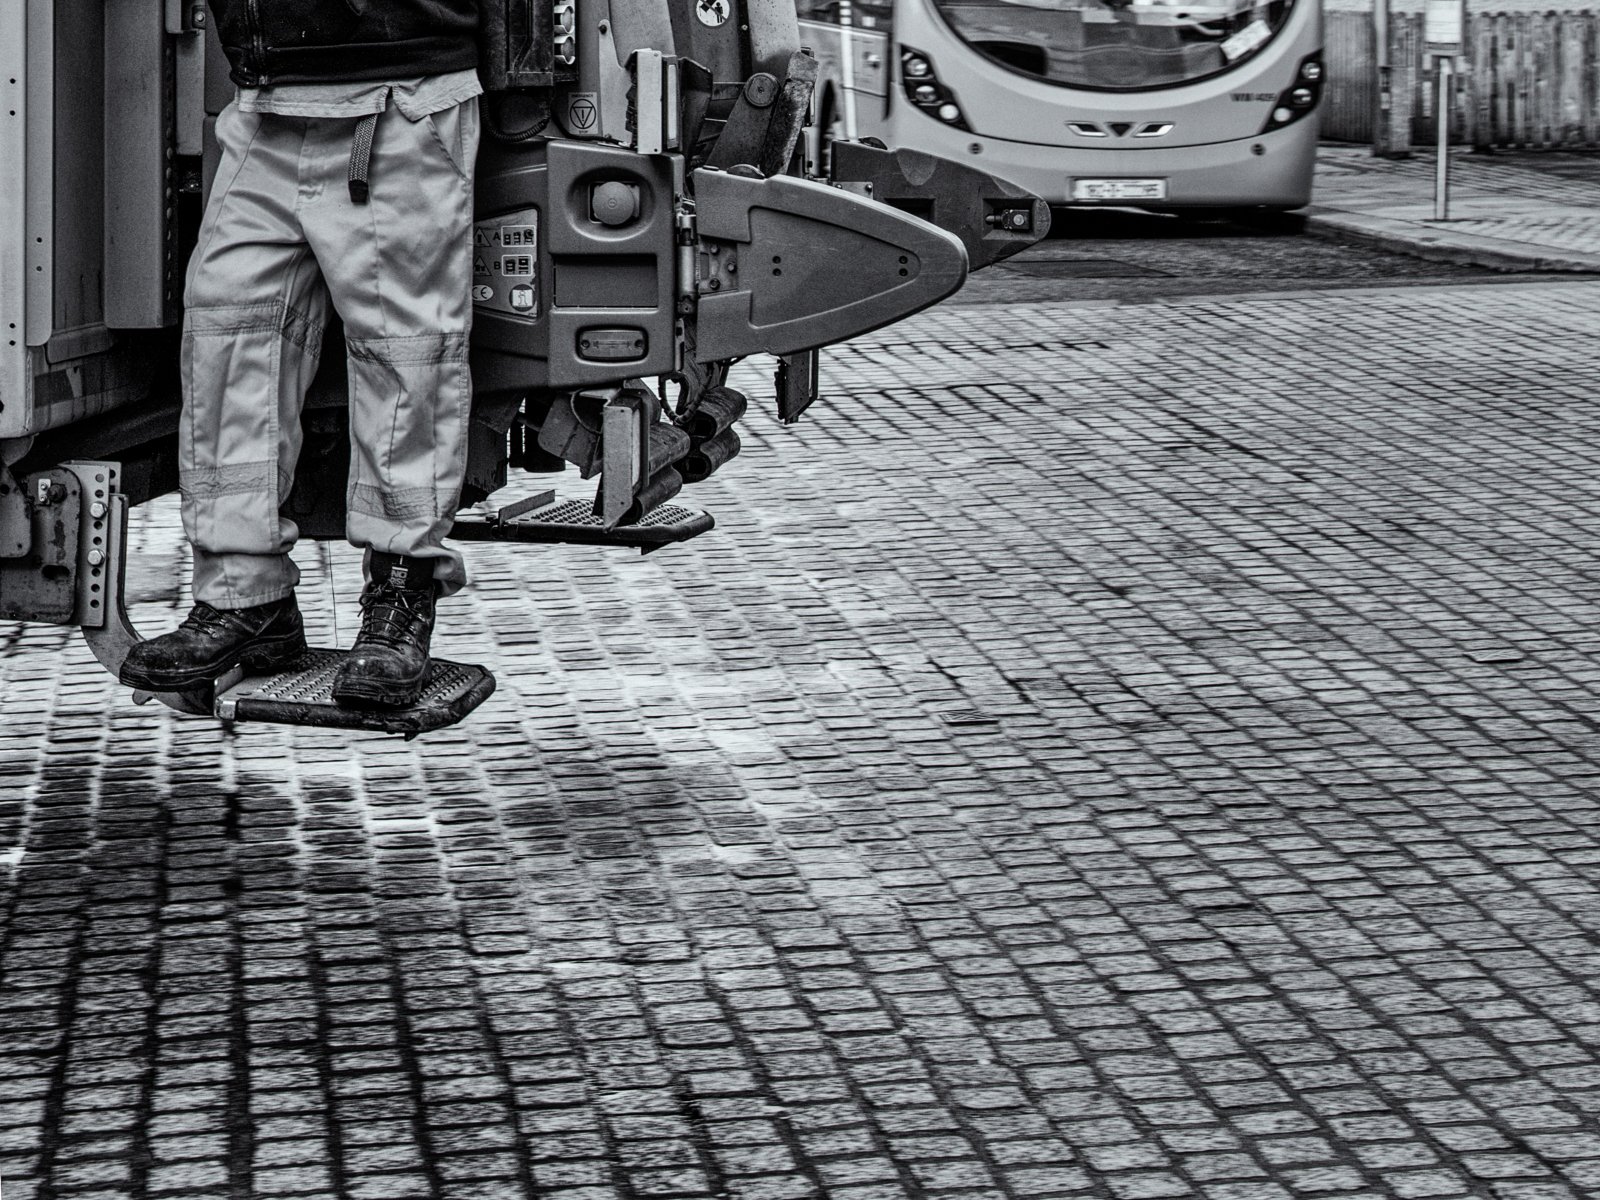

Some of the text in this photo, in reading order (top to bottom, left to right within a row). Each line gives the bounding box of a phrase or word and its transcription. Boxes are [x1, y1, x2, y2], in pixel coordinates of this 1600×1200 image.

[492, 231, 501, 241] A
[493, 261, 501, 270] B
[391, 569, 408, 579] NO
